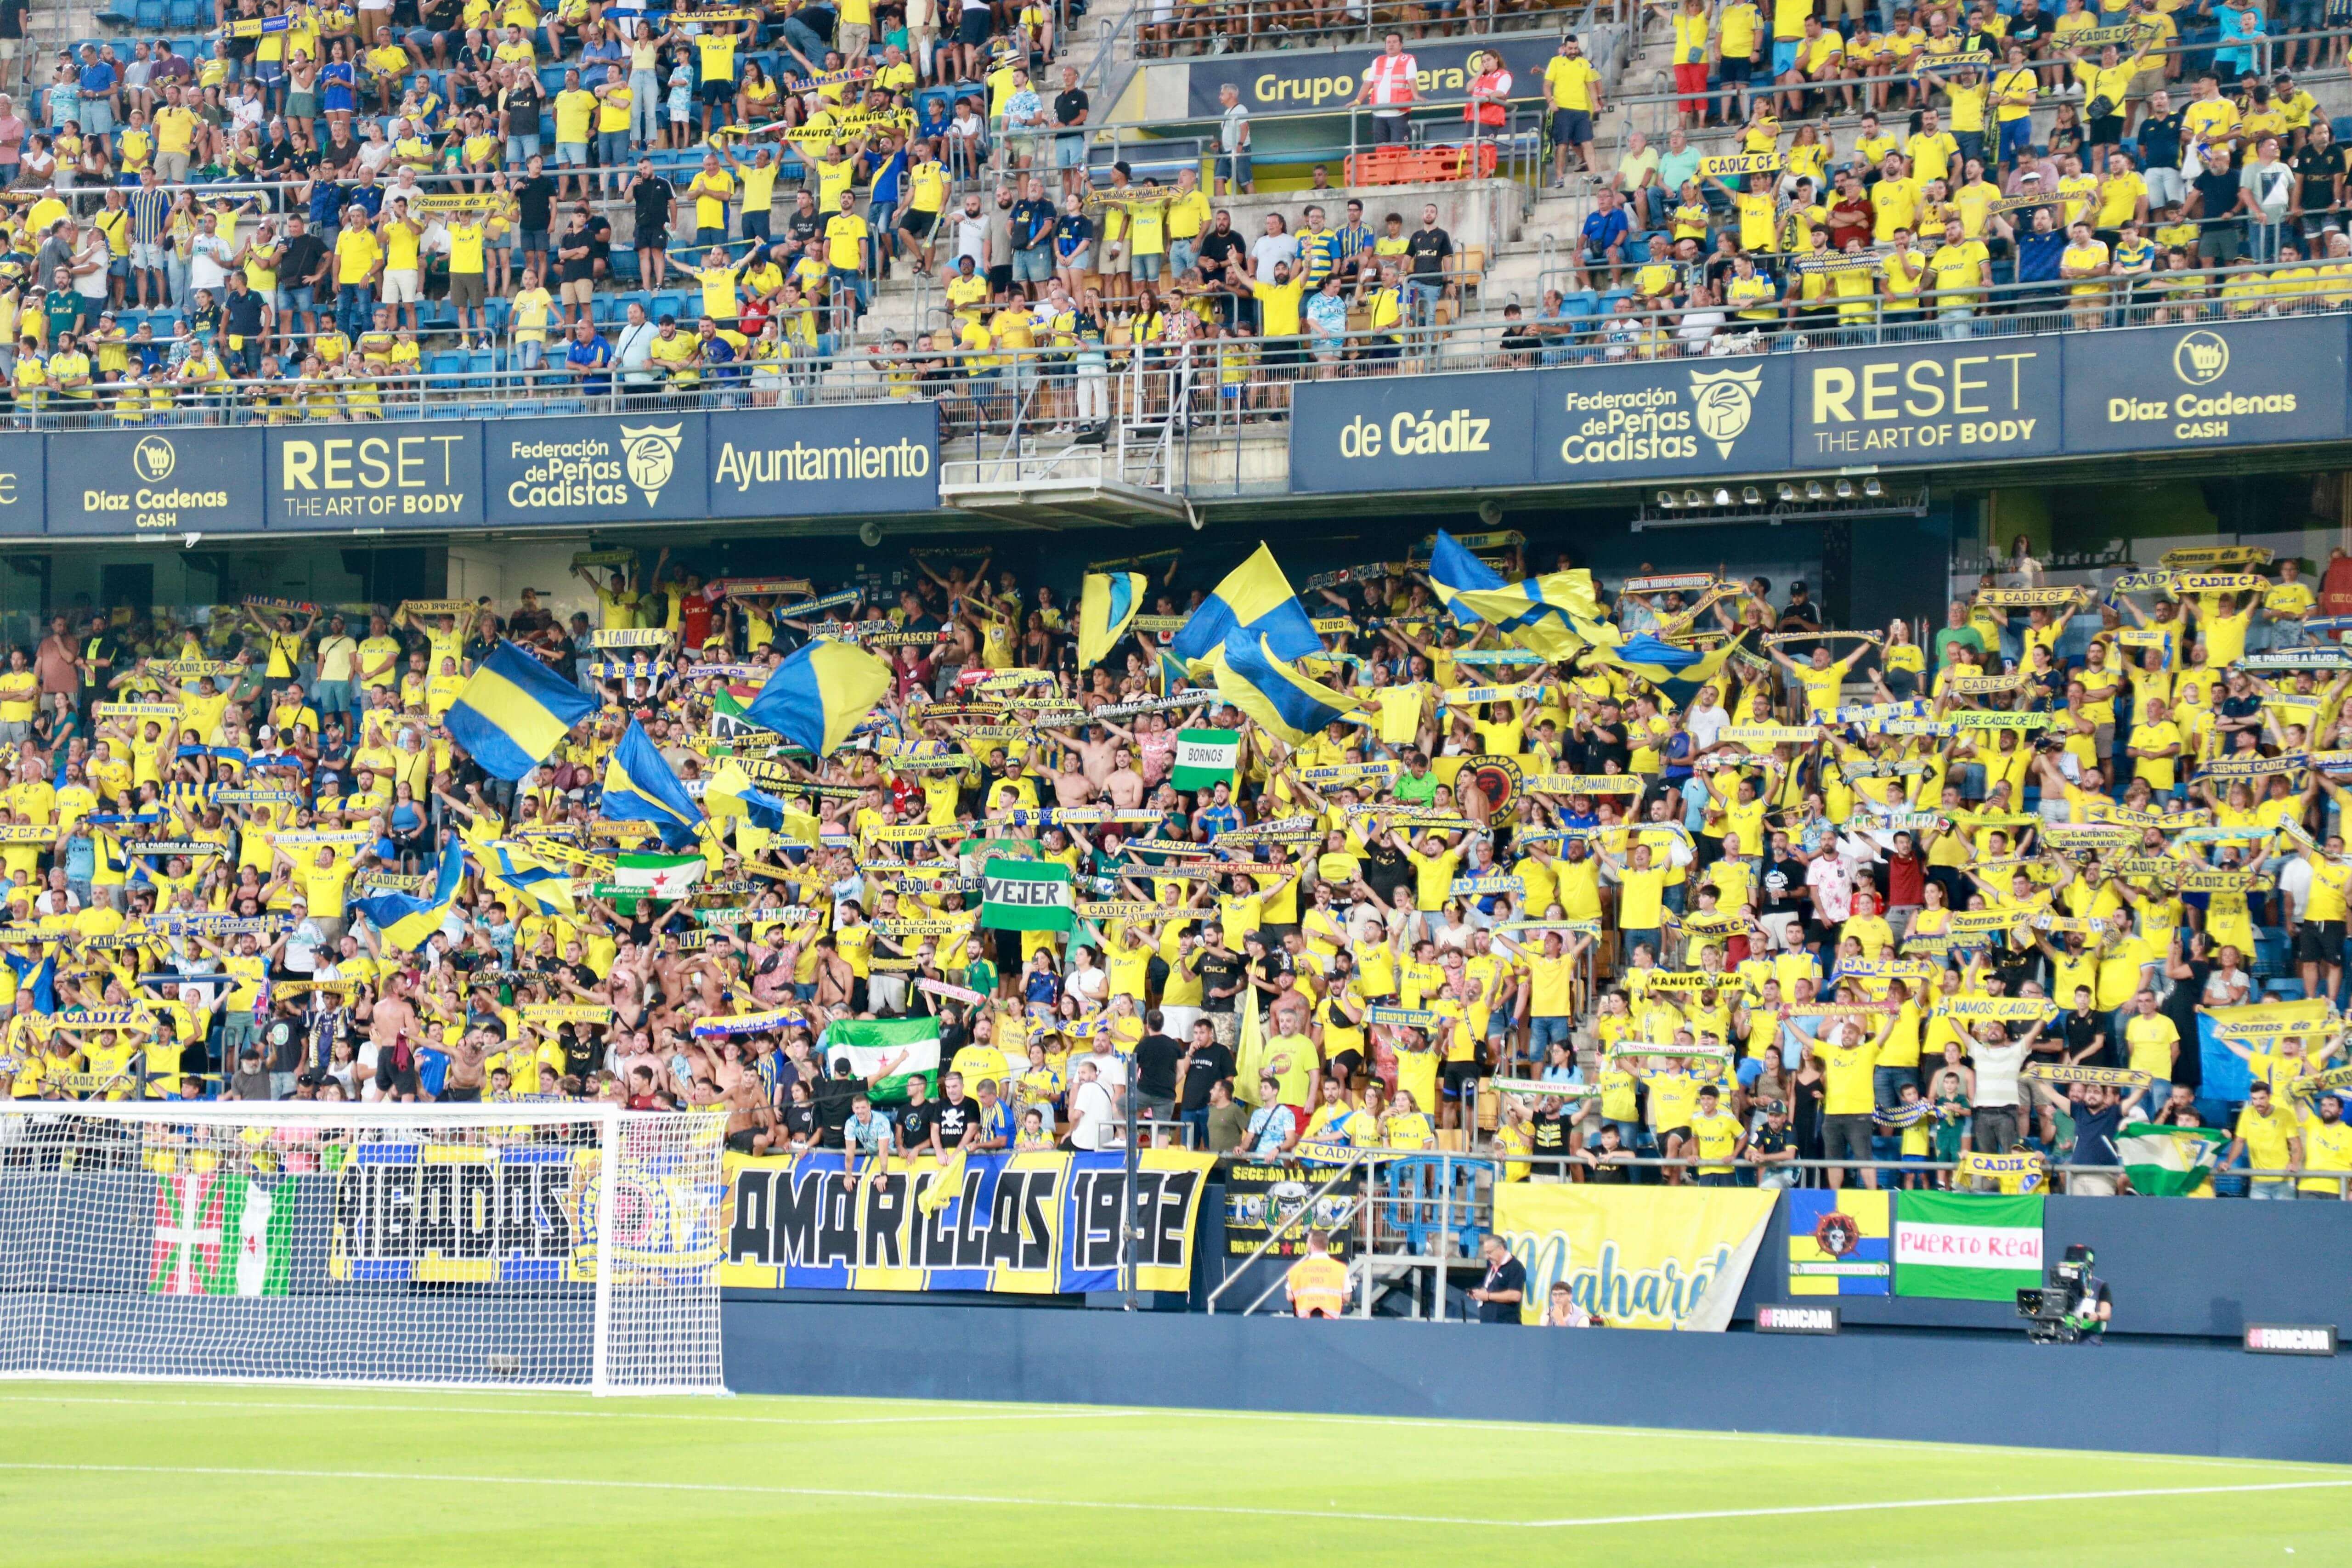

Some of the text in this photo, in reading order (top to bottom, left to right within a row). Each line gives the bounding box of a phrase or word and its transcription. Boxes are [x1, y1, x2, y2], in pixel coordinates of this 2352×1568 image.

[2079, 29, 2111, 43] CADIZ
[1255, 75, 1353, 105] Grupo
[844, 112, 883, 123] KANUTO
[790, 129, 831, 137] KANUTO
[1135, 188, 1163, 198] AMARILLAS
[421, 197, 481, 208] Somos de
[1812, 352, 2037, 425] RESET
[1567, 387, 1677, 412] Federación
[2109, 391, 2297, 423] Díaz Cadenas
[1582, 407, 1690, 436] de Peñas
[1340, 409, 1490, 458] de Cádiz
[1815, 419, 2036, 454] THE ART OF BODY
[2175, 421, 2228, 440] CASH
[511, 440, 609, 459] Federación
[1561, 431, 1697, 464] Cadistas
[283, 435, 464, 491] RESET
[525, 457, 622, 482] de Peñas
[715, 437, 930, 492] Ayuntamiento
[84, 487, 228, 512] Díaz Cadenas
[508, 480, 628, 509] Cadistas
[284, 493, 464, 517] THE ART OF BODY
[136, 512, 176, 528] CASH
[2221, 550, 2238, 560] de
[1650, 577, 1706, 587] NENAS CADISTAS
[2189, 577, 2236, 588] CADIZ
[2004, 592, 2043, 602] CADIZ
[1320, 620, 1344, 630] CADIZ
[609, 630, 638, 646] CADIZ
[872, 632, 951, 644] ANTIFASCISTS
[2250, 654, 2264, 662] DE
[2266, 654, 2300, 662] PADRES
[2311, 653, 2339, 662] HIJOS
[172, 663, 200, 673] CADIZ
[1963, 679, 2001, 690] CADIZ
[1468, 689, 1497, 702] CADIZ
[1096, 691, 1208, 714] BRIGADAS AMARILLAS
[141, 706, 175, 714] SENTIMIENTO
[975, 726, 1003, 736] CADIZ
[1732, 728, 1763, 737] PRADO
[733, 733, 780, 746] ETERNO
[1187, 747, 1223, 763] BORNOS
[2212, 761, 2287, 775] SIEMPRE CADIZ
[1547, 775, 1623, 791] PULPO AMARILLO
[1013, 809, 1053, 821] CADIZ
[2115, 808, 2160, 824] CADIZ
[275, 833, 344, 843] BEBER COMER
[1151, 838, 1197, 851] CADISTA
[1125, 866, 1209, 877] BRIGADAS AMARILLAS
[2123, 861, 2157, 872] CADIZ
[370, 873, 400, 886] CADIZ
[2187, 876, 2224, 887] CADIZ
[984, 879, 1059, 905] VEJER
[1089, 905, 1128, 915] CADIZ
[1131, 905, 1146, 914] CF
[1956, 917, 2003, 926] Somos
[91, 936, 125, 947] CADIZ
[1892, 961, 1915, 973] C.F.
[1653, 976, 1704, 986] KANUTO
[1955, 1001, 1996, 1014] VAMOS
[723, 1015, 763, 1030] CADIZ
[1375, 1011, 1407, 1023] SIEMPRE
[2231, 1020, 2311, 1033] Somos de
[67, 1076, 94, 1086] CADIZ
[2052, 1068, 2120, 1081] CADIZ CF
[1314, 1146, 1360, 1160] CADIZ
[1973, 1157, 2026, 1172] CADIZ
[1232, 1165, 1352, 1182] SECCIÓN LA JANA
[336, 1161, 575, 1260] RIGADAS
[728, 1167, 1060, 1272] AMARILLAS
[1760, 1308, 1833, 1329] #FANCAM
[2247, 1327, 2329, 1350] #FANCAM
